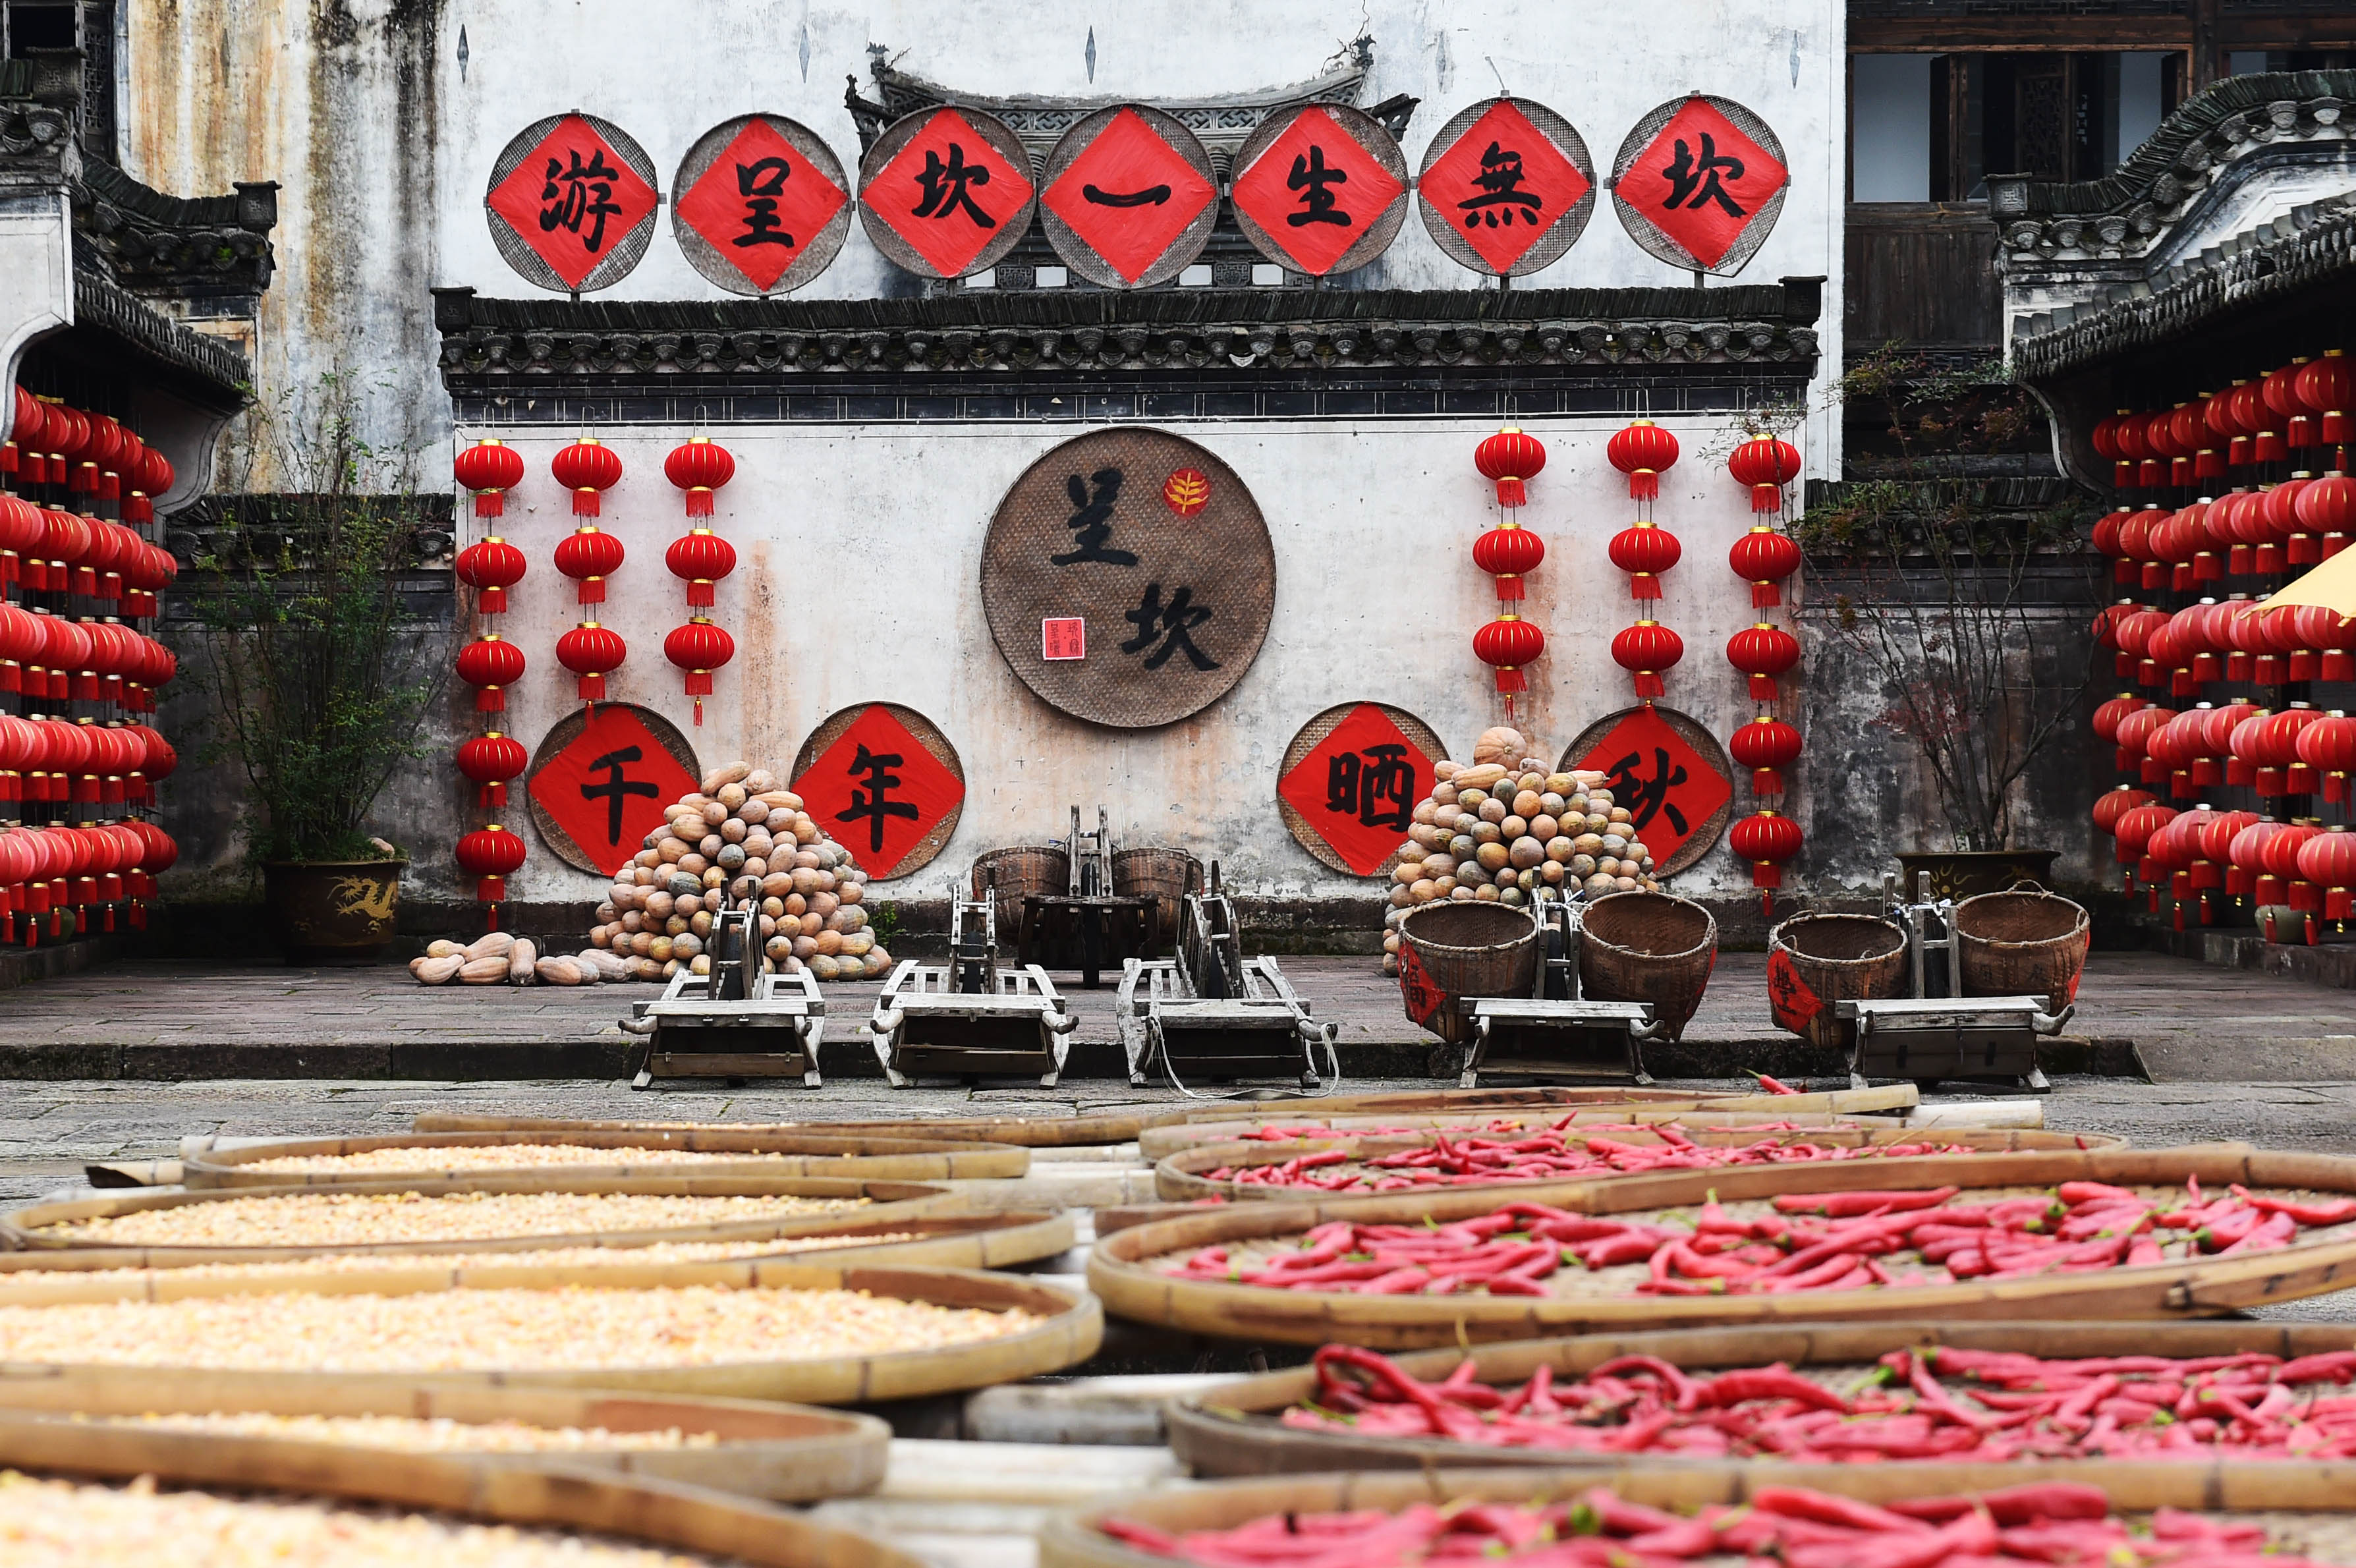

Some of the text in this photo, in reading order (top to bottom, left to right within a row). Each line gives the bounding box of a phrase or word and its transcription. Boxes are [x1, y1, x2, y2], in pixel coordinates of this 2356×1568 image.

[581, 744, 1688, 853] 千 年 晒 秋
